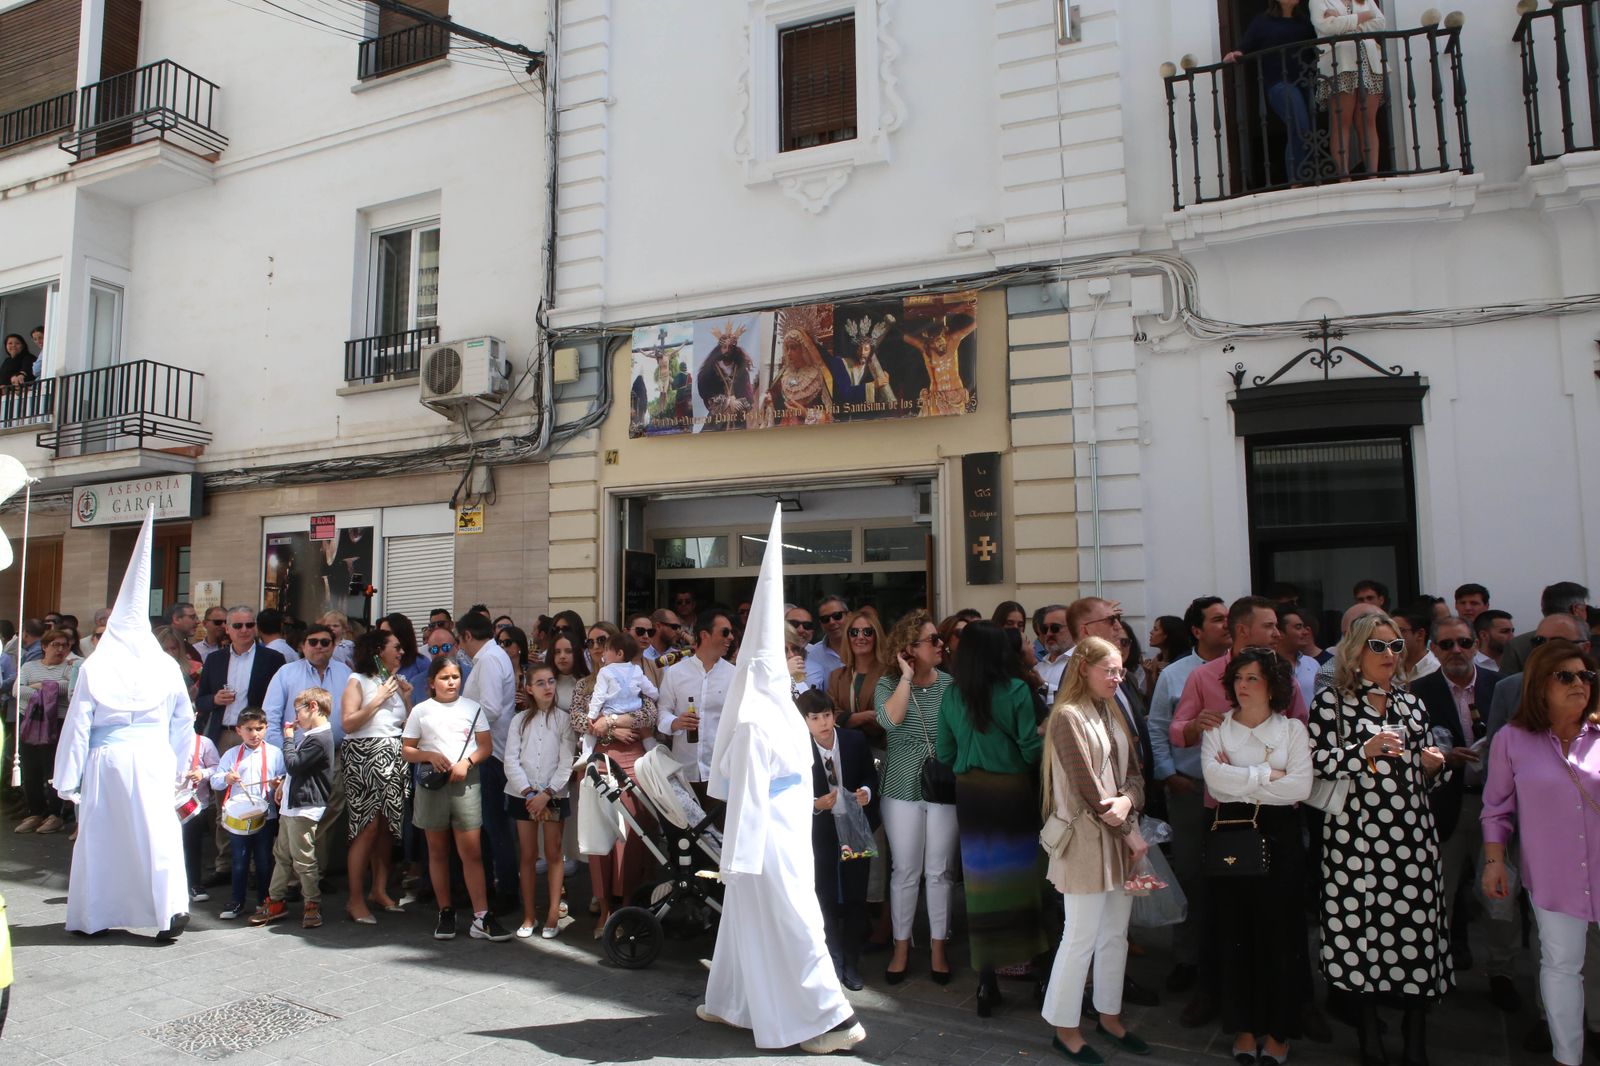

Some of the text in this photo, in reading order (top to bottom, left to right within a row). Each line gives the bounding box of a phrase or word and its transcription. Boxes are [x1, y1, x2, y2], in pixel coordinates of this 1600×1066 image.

[715, 412, 738, 425] Padre
[843, 400, 886, 413] Santísima
[889, 400, 899, 410] de
[901, 399, 914, 409] los
[107, 478, 180, 496] ASESORÍA
[112, 491, 174, 514] GARCÍA
